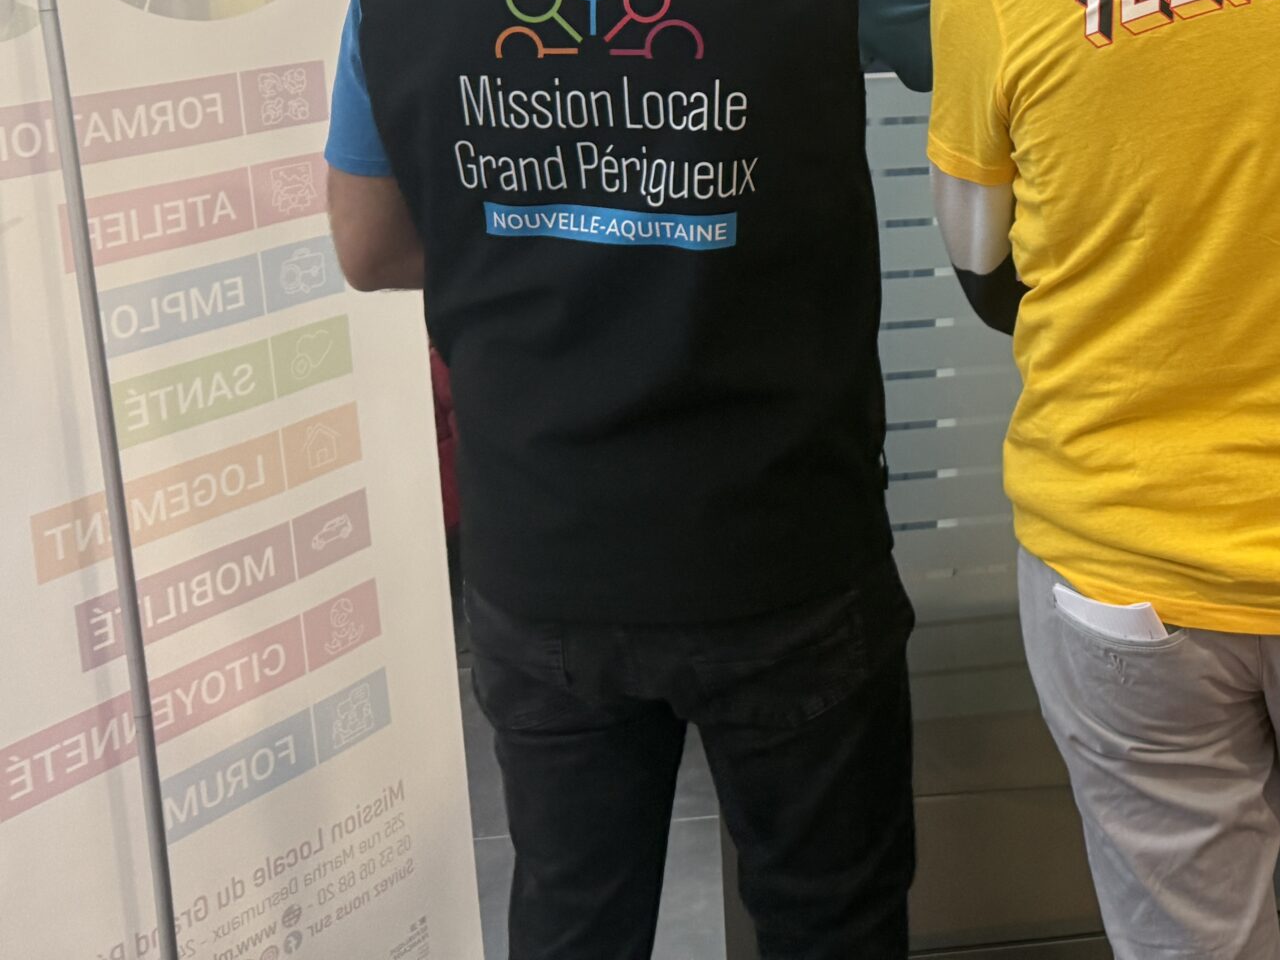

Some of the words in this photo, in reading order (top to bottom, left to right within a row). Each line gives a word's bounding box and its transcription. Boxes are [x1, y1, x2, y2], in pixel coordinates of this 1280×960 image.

[459, 74, 614, 129] Mission
[622, 75, 748, 132] Locale
[454, 140, 567, 192] Grand
[576, 141, 759, 208] Périgueux
[492, 211, 728, 242] NOUVELLE-AQUITAINE
